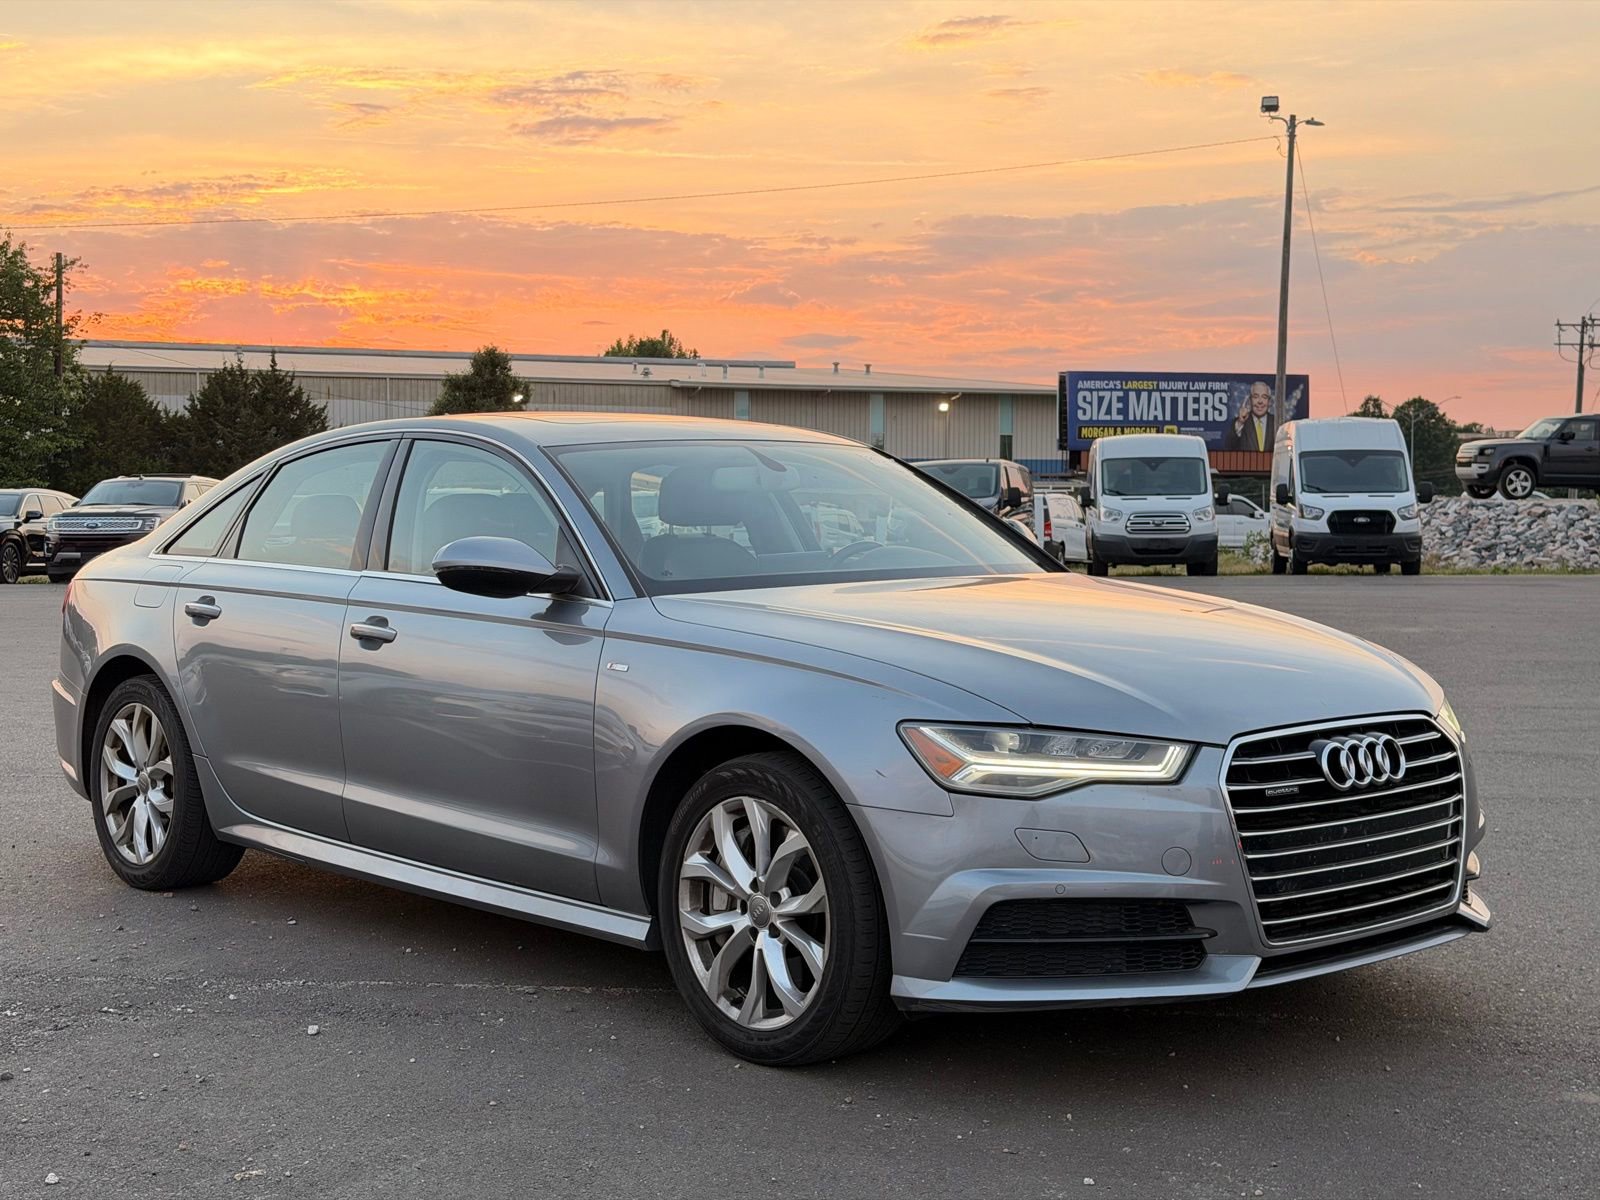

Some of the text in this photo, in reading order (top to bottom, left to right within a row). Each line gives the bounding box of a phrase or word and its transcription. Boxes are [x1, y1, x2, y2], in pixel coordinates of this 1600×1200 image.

[1077, 380, 1228, 390] AMERICA'S LARGEST INJURY LAW FIRM
[1077, 391, 1228, 422] SIZE MATTERS
[1081, 426, 1114, 438] MORGAN
